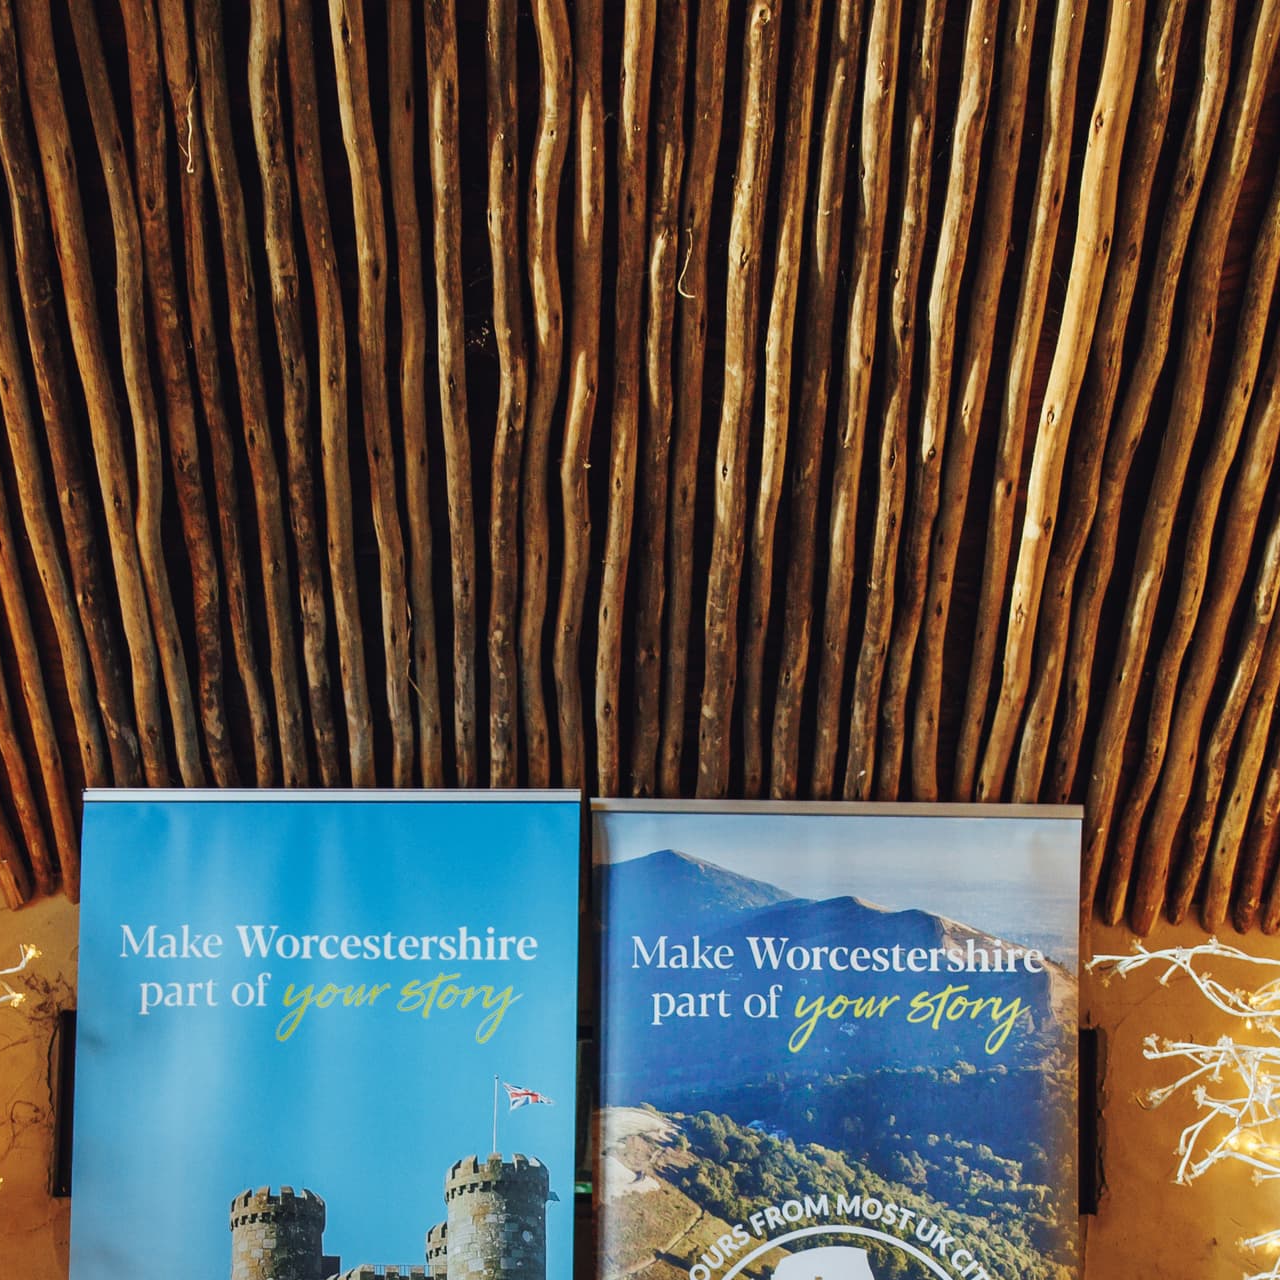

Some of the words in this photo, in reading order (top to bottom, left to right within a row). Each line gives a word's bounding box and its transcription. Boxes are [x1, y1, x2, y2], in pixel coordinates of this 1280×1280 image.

[120, 924, 223, 959] Make
[235, 925, 538, 961] Worcestershire
[631, 936, 734, 970] Make
[745, 936, 1044, 974] Worcestershire
[139, 975, 218, 1015] part
[231, 972, 272, 1007] of
[275, 980, 391, 1042] your
[397, 971, 523, 1044] story
[651, 988, 731, 1025] part
[744, 985, 783, 1018] of
[788, 993, 900, 1053] your
[907, 984, 1031, 1055] story
[749, 1195, 829, 1236] FROM
[837, 1196, 915, 1231] MOST
[916, 1221, 953, 1256] UK
